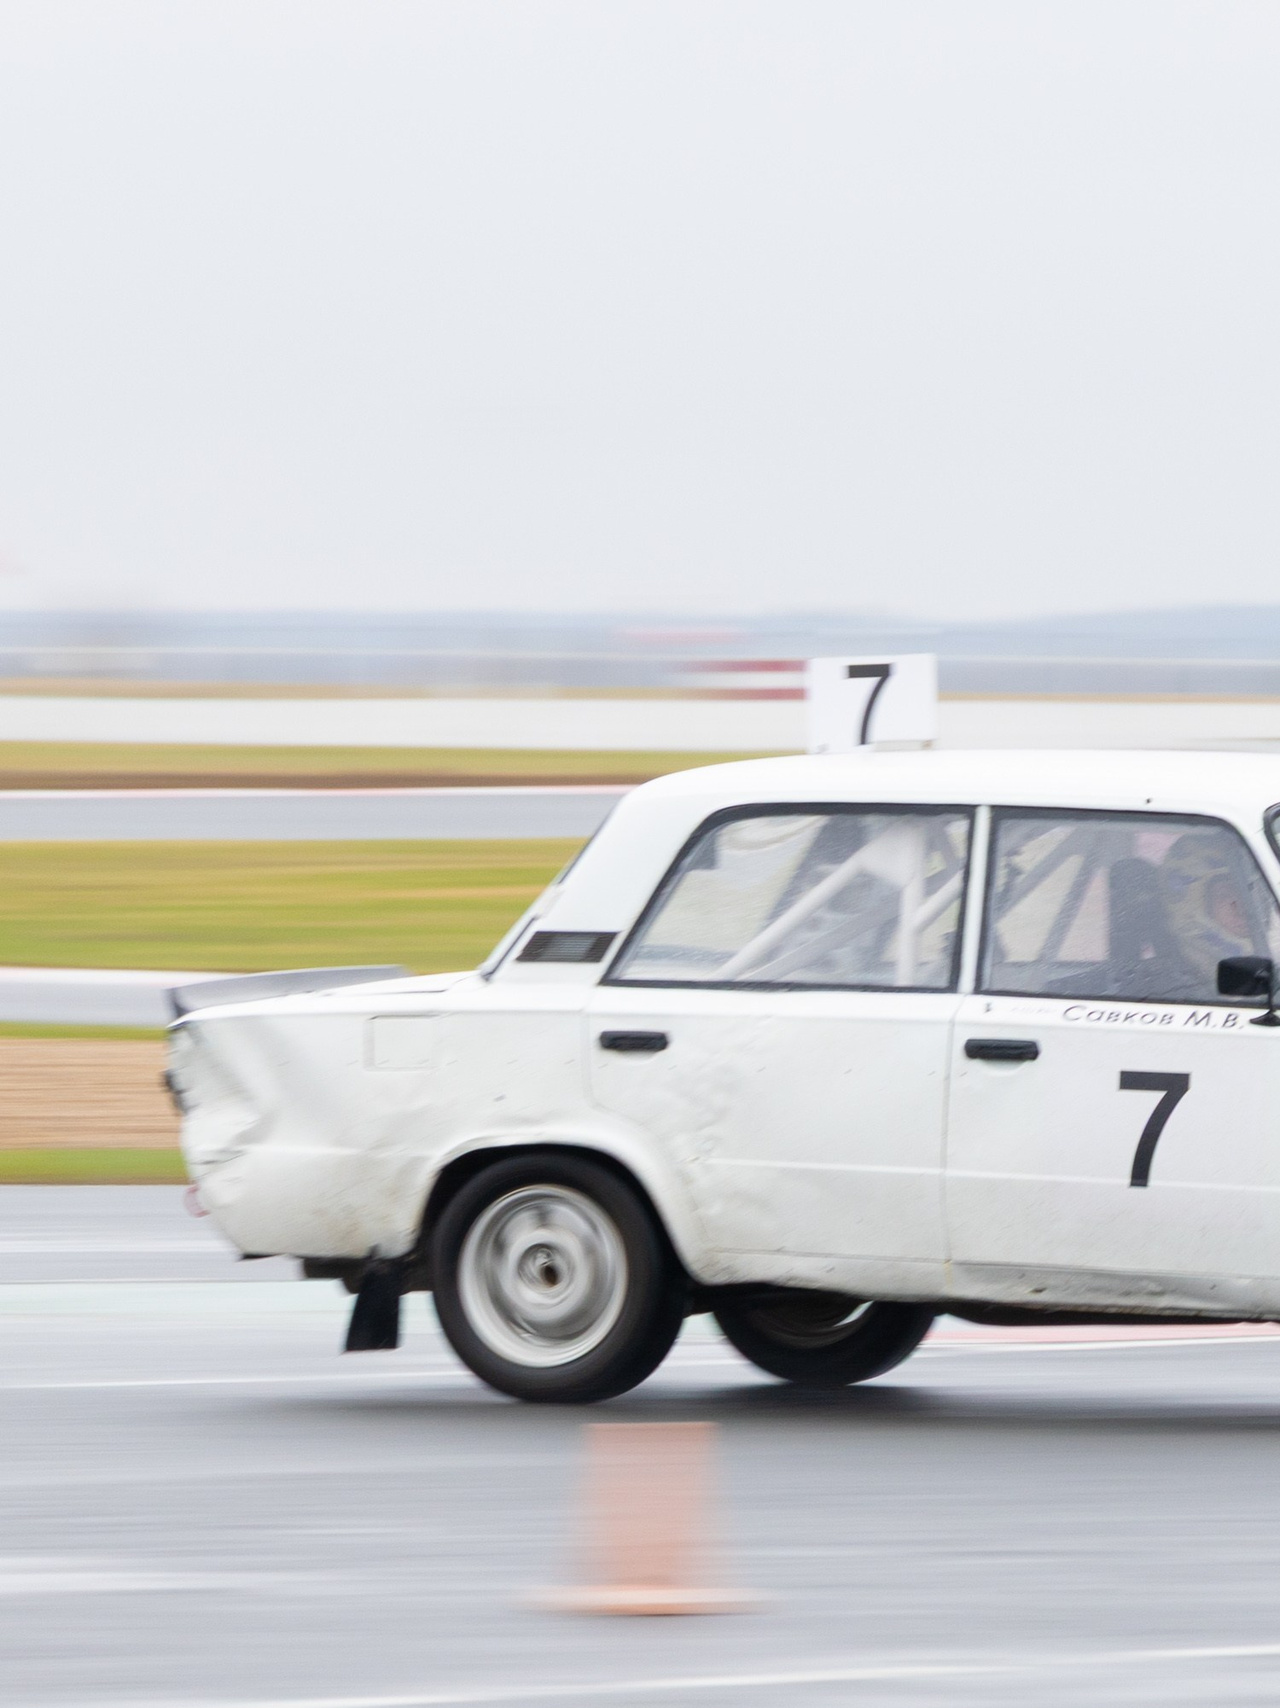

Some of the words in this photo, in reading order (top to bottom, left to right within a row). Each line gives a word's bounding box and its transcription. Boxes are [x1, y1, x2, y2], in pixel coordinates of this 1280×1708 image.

[843, 663, 893, 746] 7
[1062, 1004, 1173, 1026] Савков
[1118, 1070, 1191, 1187] 7
